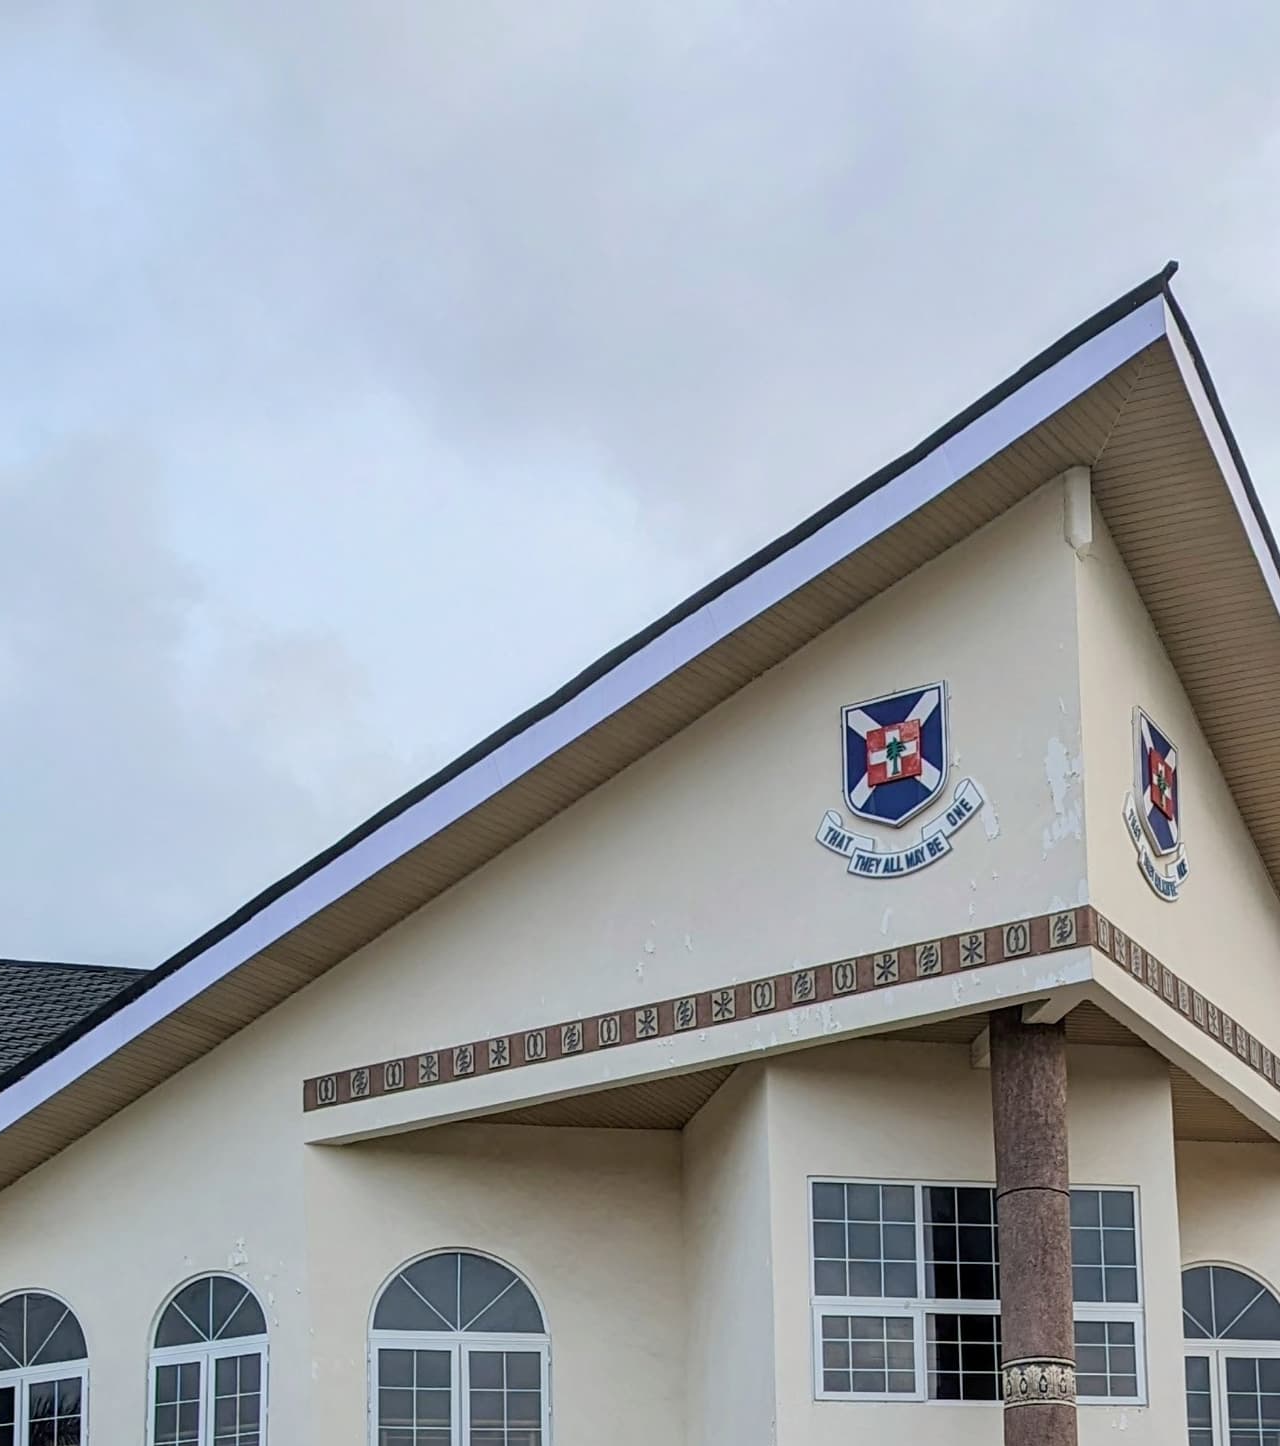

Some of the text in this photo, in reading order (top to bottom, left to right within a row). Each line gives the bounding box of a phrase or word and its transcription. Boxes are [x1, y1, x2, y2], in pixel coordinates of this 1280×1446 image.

[823, 798, 973, 874] THAT THEY ALL MAY BE ONE
